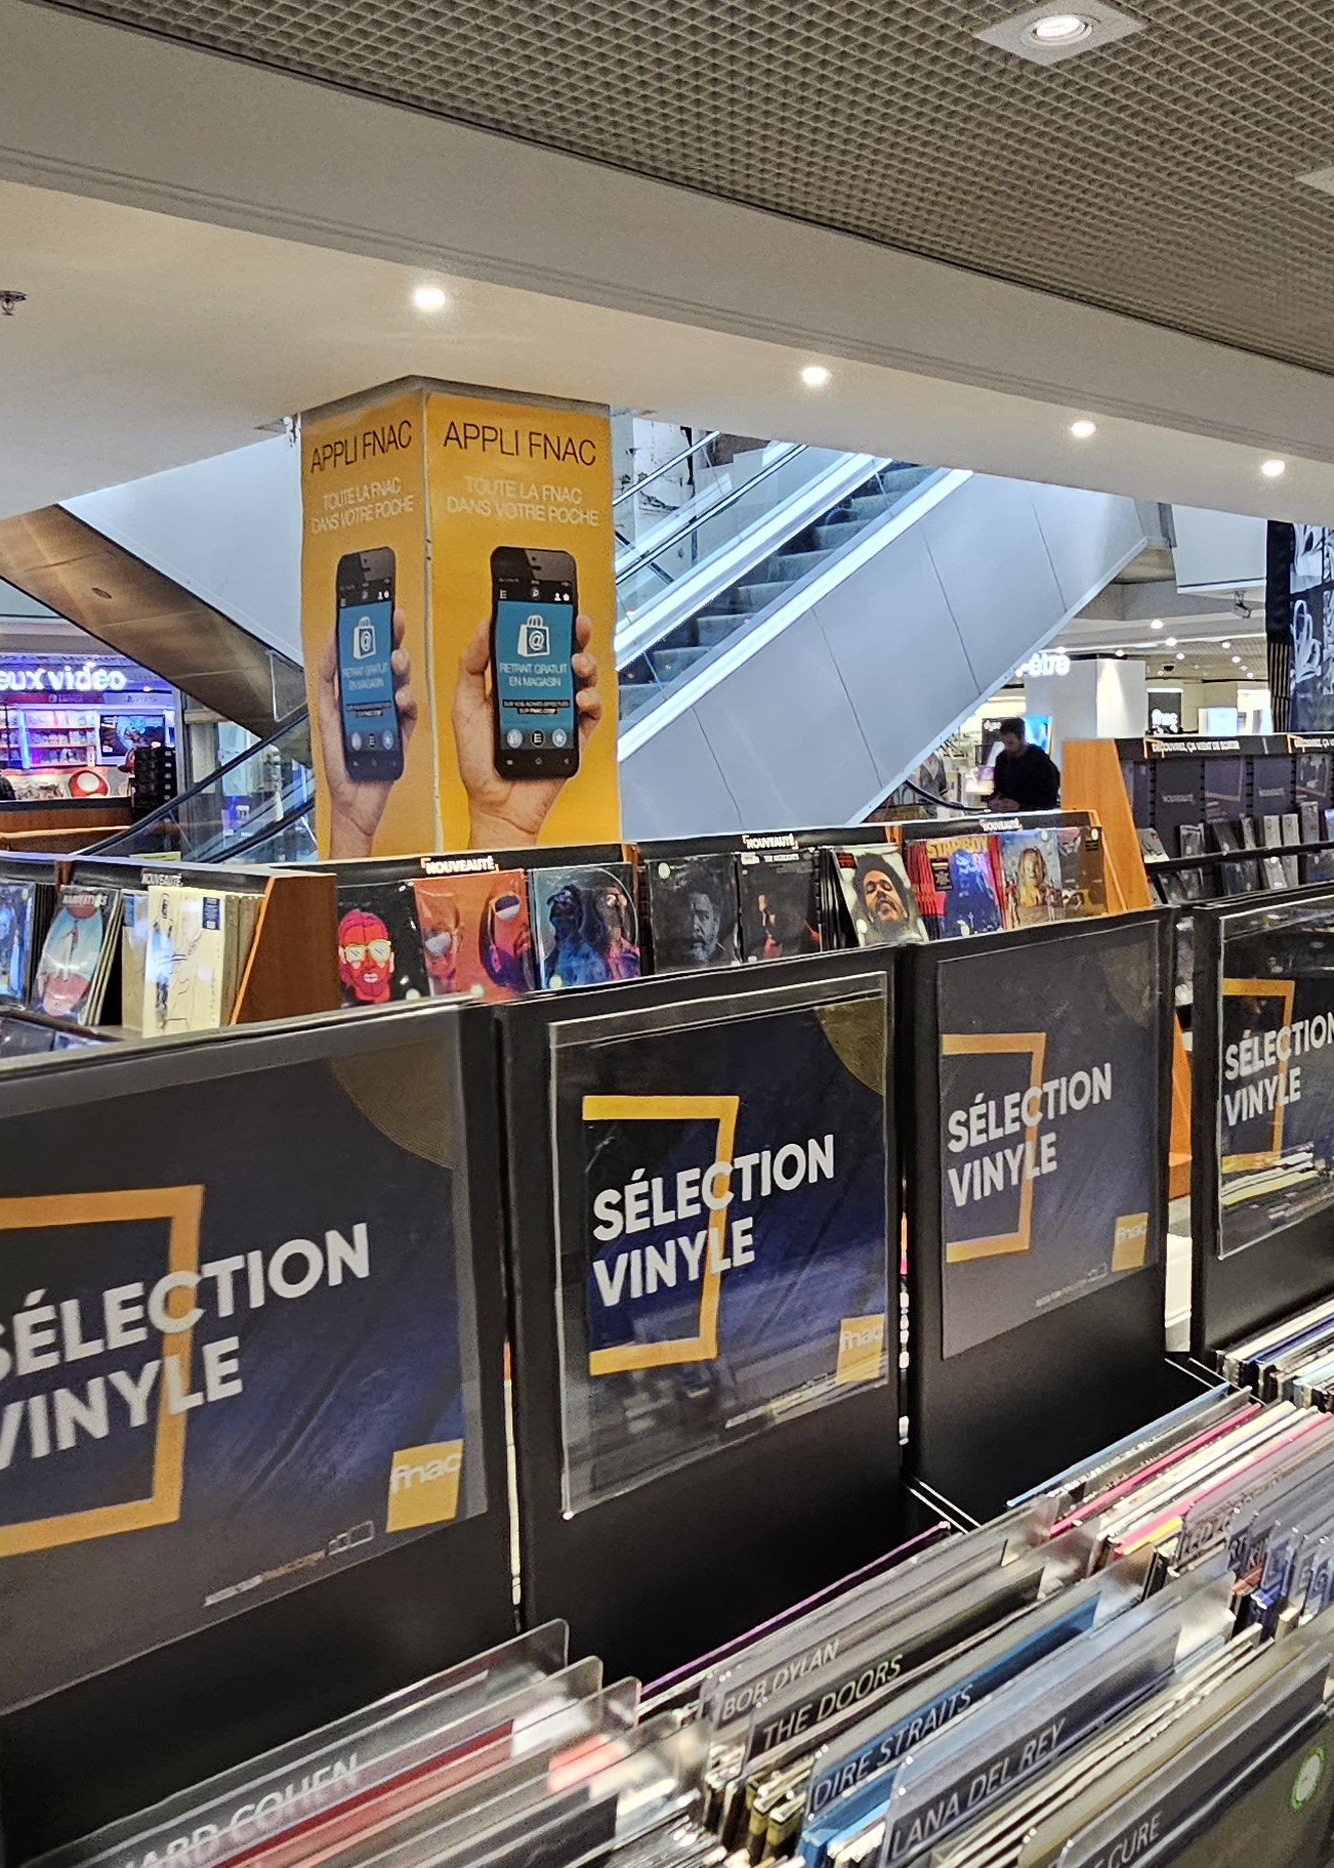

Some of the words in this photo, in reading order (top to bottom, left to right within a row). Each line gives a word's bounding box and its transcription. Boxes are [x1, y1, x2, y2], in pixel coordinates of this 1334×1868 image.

[310, 435, 357, 474] APPLI
[363, 420, 412, 459] FNAC
[443, 421, 519, 456] APPLI
[529, 431, 596, 466] FNAC
[323, 487, 355, 511] TOUTE
[356, 484, 370, 502] LA
[371, 476, 402, 498] FNAC
[447, 496, 492, 517] DANS
[495, 502, 546, 522] VOTRE
[548, 507, 599, 527] POCHE
[464, 475, 517, 498] TOUTE
[520, 482, 539, 500] LA
[542, 484, 582, 505] FNAC
[311, 514, 339, 535] DANS
[339, 504, 375, 529] VOTRE
[375, 495, 414, 519] POCHE
[500, 663, 532, 674] RETRAIT
[534, 663, 568, 674] GRATUIT
[509, 676, 522, 687] EN
[523, 677, 562, 687] MAGASIN
[746, 833, 794, 849] NOUVEAUTÉ
[426, 855, 495, 875] NOUVEAUTÉ
[947, 1063, 1113, 1153] SÉLECTION
[1224, 1066, 1301, 1127] VINYLE
[593, 1134, 835, 1241] SÉLECTION
[947, 1132, 1057, 1208] VINYLE
[1115, 1222, 1148, 1244] fnac
[593, 1216, 755, 1307] VINYLE
[841, 1327, 883, 1350] fnac
[390, 1453, 462, 1495] fnac
[722, 1678, 766, 1719] BOB
[770, 1639, 839, 1691] DYLAN
[764, 1708, 813, 1747] THE
[816, 1654, 903, 1719] DOORS
[814, 1754, 876, 1810] DIRE
[878, 1686, 973, 1769] STRAITS
[228, 1752, 361, 1843] COHEN
[891, 1799, 961, 1859] LANA
[968, 1761, 1015, 1810] DEL
[1018, 1717, 1067, 1771] REY
